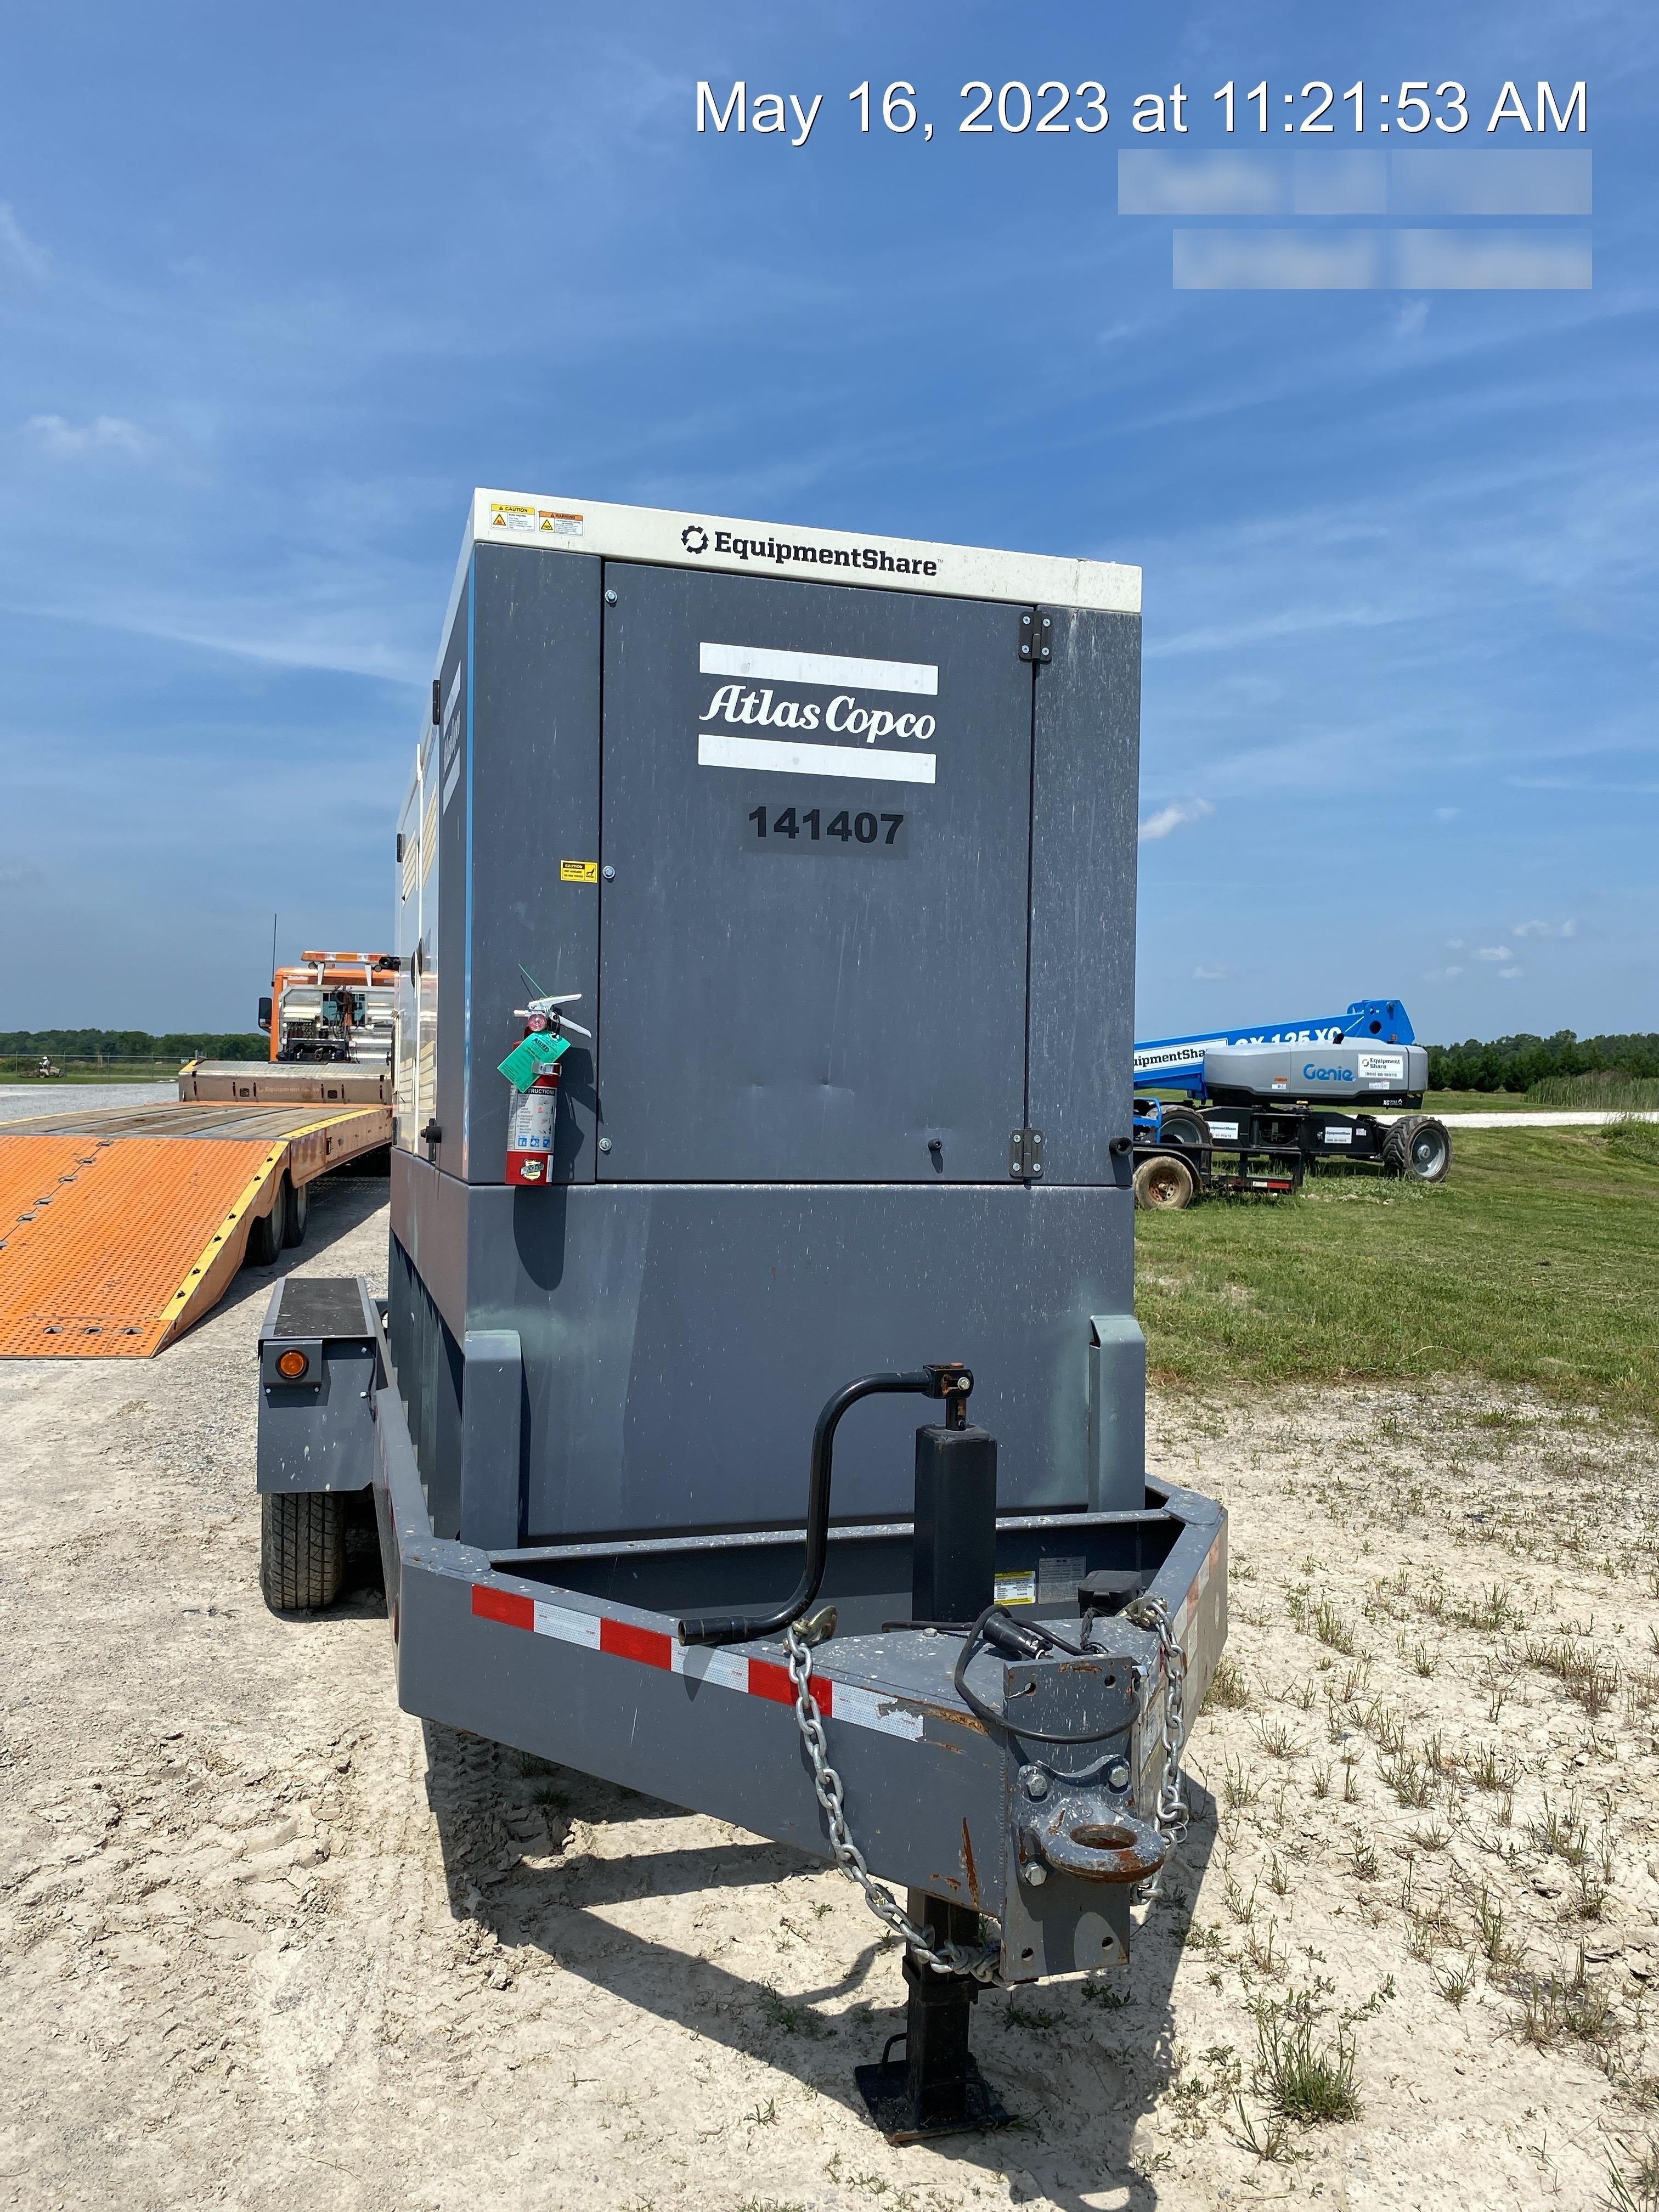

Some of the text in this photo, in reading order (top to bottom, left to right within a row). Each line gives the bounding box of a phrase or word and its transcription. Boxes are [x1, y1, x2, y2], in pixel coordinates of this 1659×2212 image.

[714, 531, 937, 577] EquipmentShare
[698, 684, 936, 743] Atlas Copco
[748, 806, 904, 844] 141407
[1133, 1048, 1207, 1068] uipmentSha
[1303, 1063, 1354, 1082] Genie
